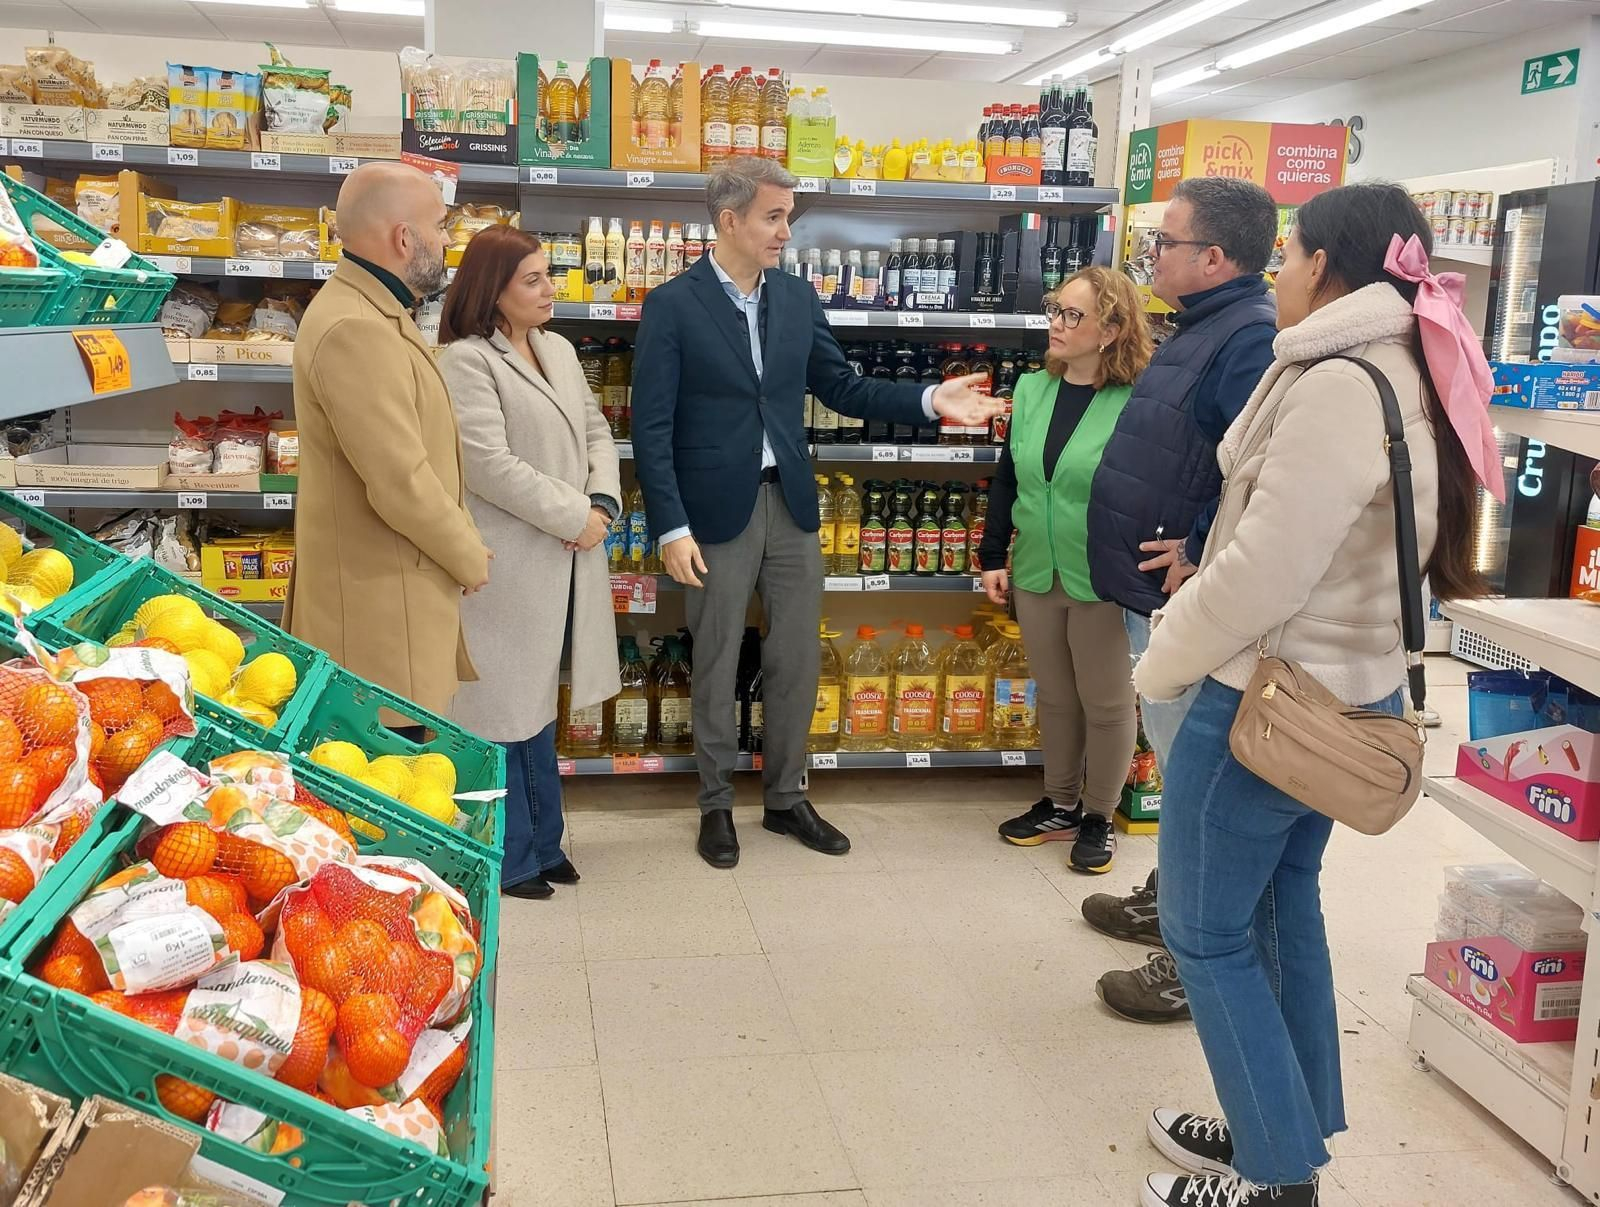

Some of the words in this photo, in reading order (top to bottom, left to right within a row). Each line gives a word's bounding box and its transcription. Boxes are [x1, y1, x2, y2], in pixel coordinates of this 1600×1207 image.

[20, 116, 60, 124] NATURMUNDO
[466, 112, 498, 120] GRISSINIS
[108, 122, 147, 130] NATURMUNDO
[469, 143, 508, 152] GRISSINIS
[1158, 144, 1184, 159] combina
[1203, 142, 1244, 164] pick
[1277, 144, 1338, 160] combina
[626, 154, 656, 165] Vinagre
[1130, 148, 1148, 170] pick
[1162, 156, 1180, 167] como
[1286, 156, 1326, 170] como
[1130, 166, 1151, 182] &mix
[1157, 167, 1181, 182] quieras
[1206, 161, 1254, 179] &mix
[1278, 168, 1331, 185] quieras
[236, 348, 272, 360] Picos
[1562, 370, 1585, 378] HARIBO
[70, 476, 98, 484] integral
[111, 478, 130, 486] trigo
[194, 480, 240, 489] Reventaos
[904, 692, 932, 700] COOSOL
[1530, 786, 1572, 823] Fini
[1464, 948, 1494, 980] Fini
[1534, 958, 1562, 974] Fini
